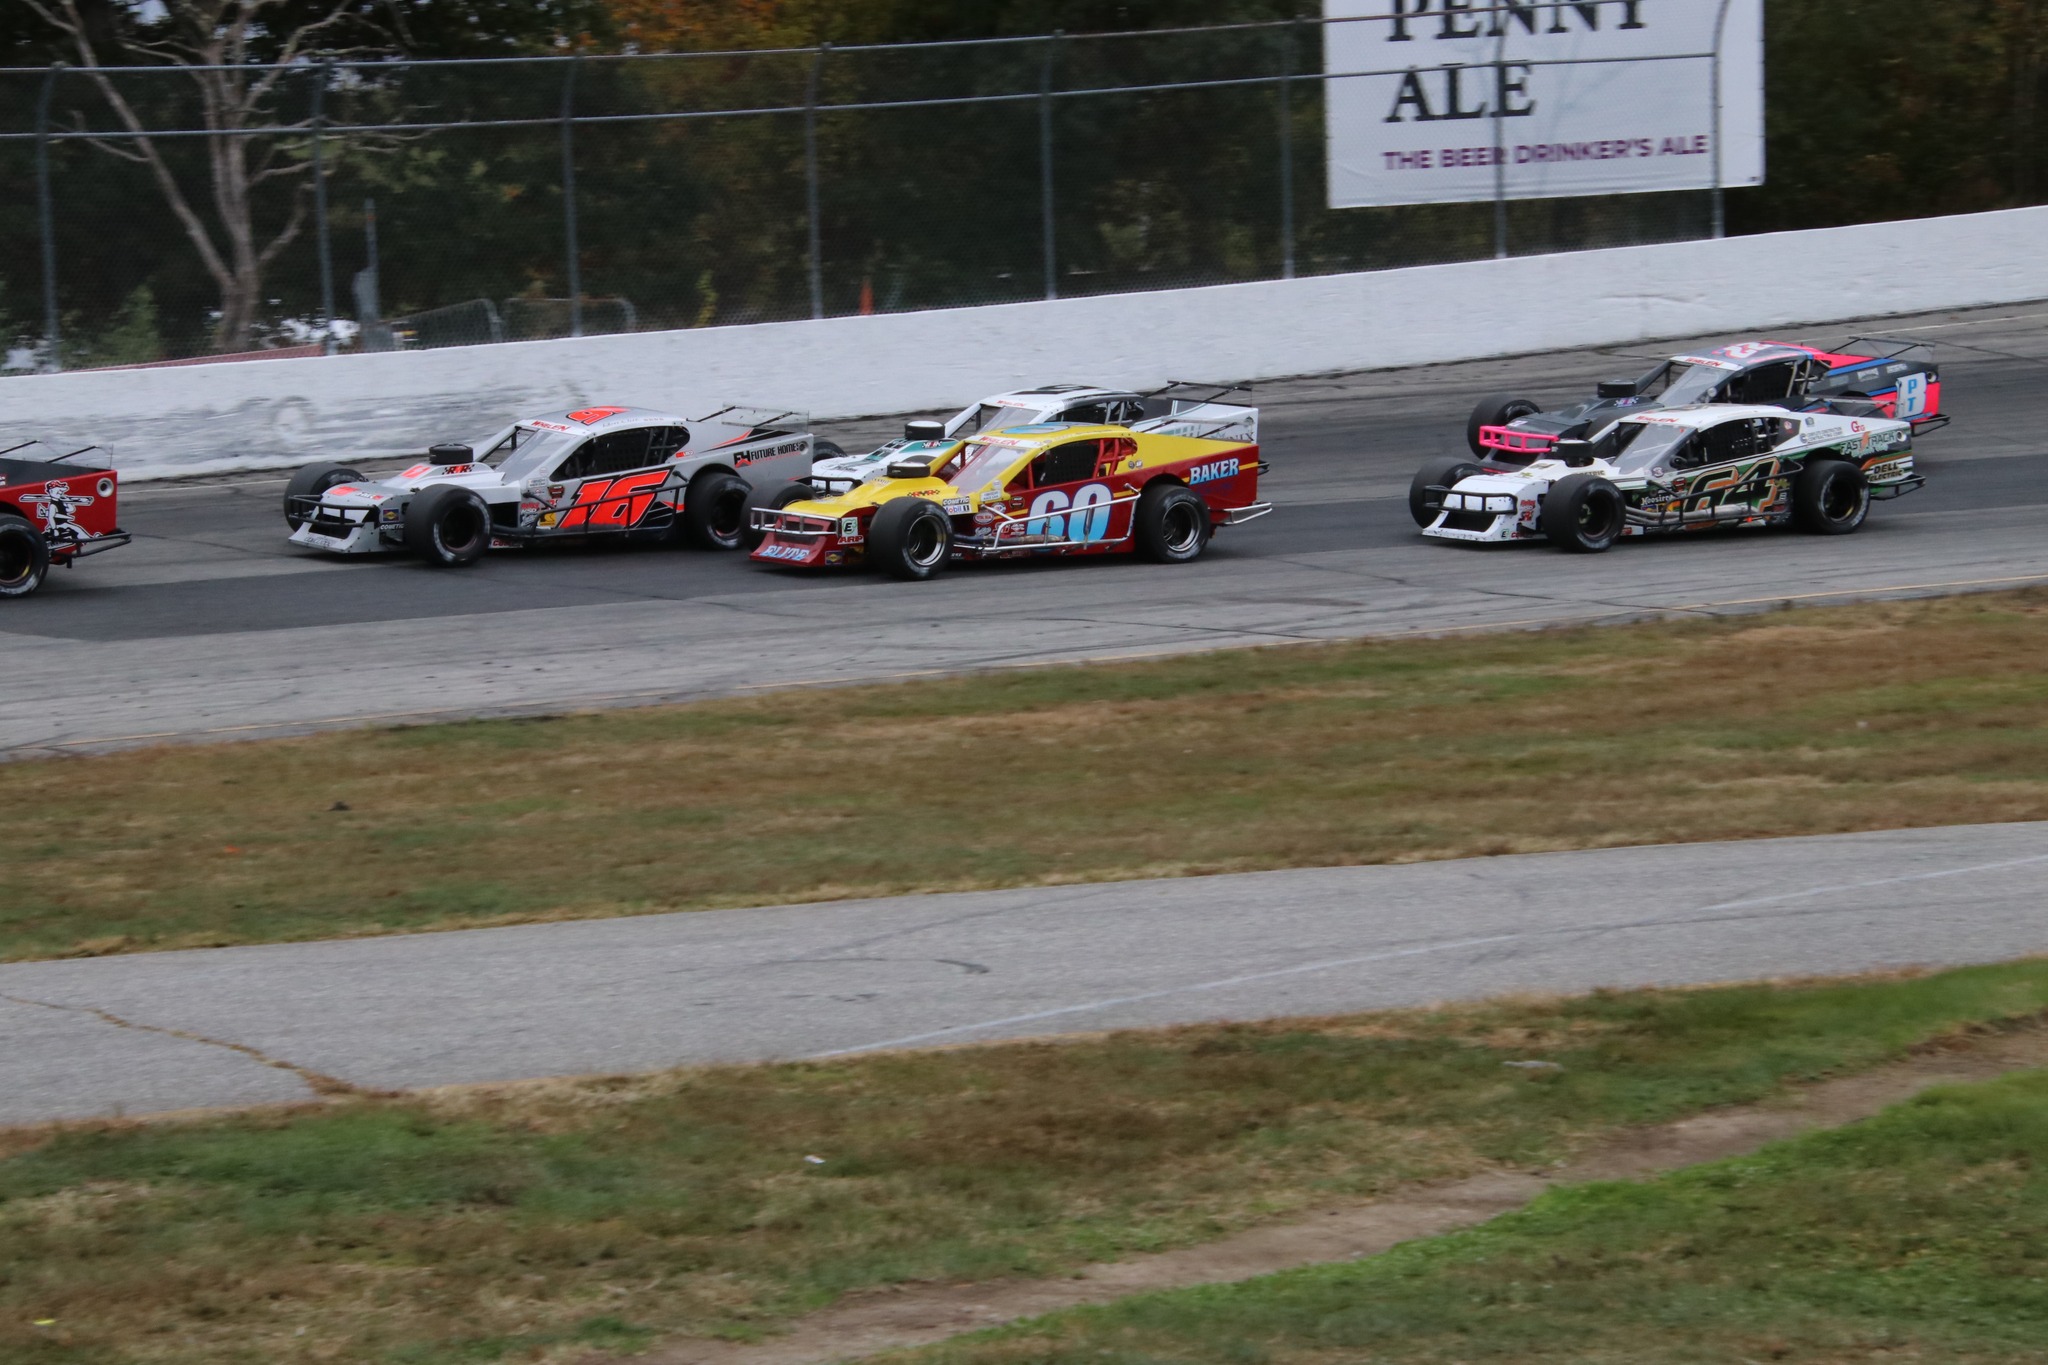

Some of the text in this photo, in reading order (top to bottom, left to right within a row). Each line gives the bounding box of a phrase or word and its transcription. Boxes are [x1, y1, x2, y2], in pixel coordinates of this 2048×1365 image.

[1386, 0, 1647, 42] PENNY
[1383, 60, 1537, 123] ALE
[1383, 135, 1708, 171] THE BEER DRINKER'S ALE
[1908, 379, 1917, 394] P
[1907, 397, 1916, 412] T
[751, 447, 776, 460] FUTURE
[1190, 458, 1240, 485] BAKER
[1874, 462, 1899, 474] DELL
[559, 470, 670, 529] 16
[1683, 457, 1780, 522] 64
[943, 496, 970, 506] COMETIC
[1027, 483, 1112, 552] 60
[838, 535, 863, 544] ARP
[760, 545, 810, 561] ELITE
